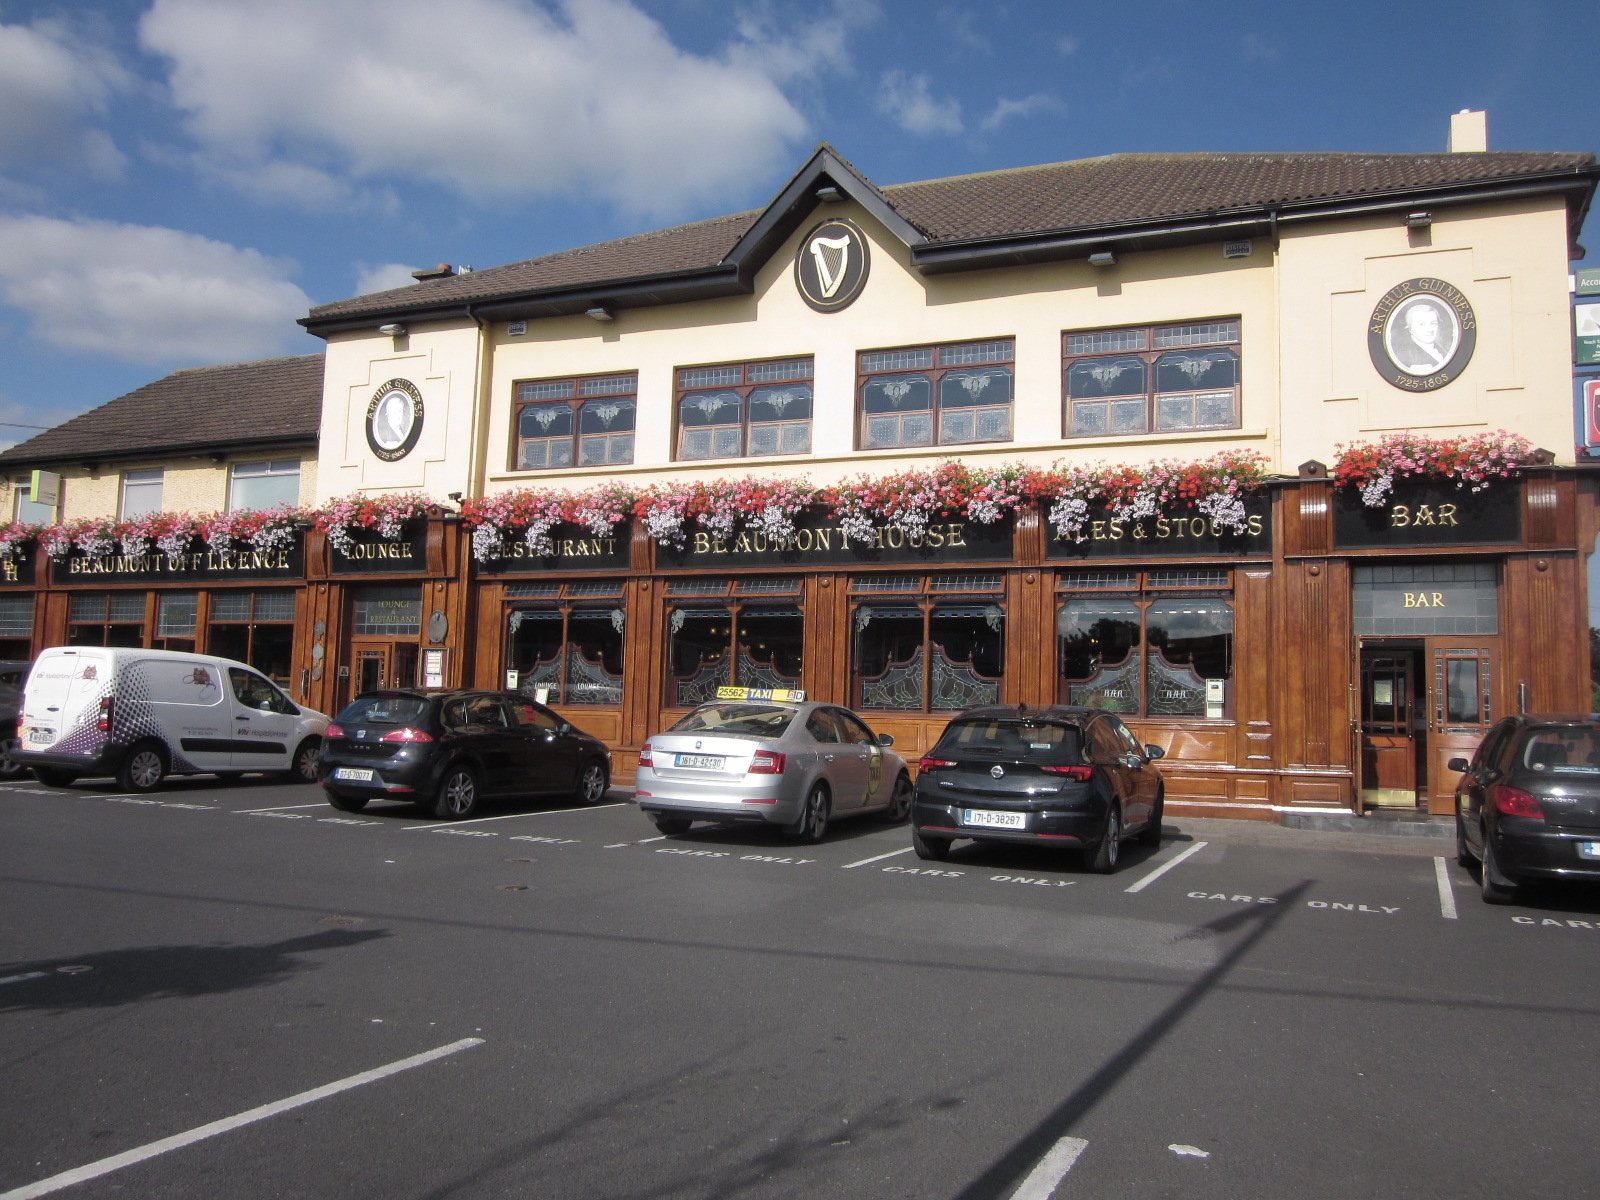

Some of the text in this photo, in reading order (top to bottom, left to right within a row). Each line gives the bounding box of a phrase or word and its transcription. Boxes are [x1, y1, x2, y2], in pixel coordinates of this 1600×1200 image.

[1581, 279, 1600, 288] Acco
[1371, 278, 1476, 334] ARTHUR GUINNESS
[1391, 503, 1458, 527] BAR
[1132, 523, 1148, 539] &
[1156, 514, 1264, 538] STOUS
[693, 527, 850, 554] BEAUMONT
[69, 554, 164, 575] BEAUMONT
[378, 600, 411, 609] LOUNGE
[1403, 592, 1446, 608] BAR
[369, 615, 417, 624] RESTAURANT
[718, 687, 744, 697] 25562
[749, 688, 773, 699] TAXI
[1103, 689, 1124, 698] BAR
[973, 811, 1021, 825] 171-D-38287
[881, 866, 1077, 887] CARS ONLY
[1187, 891, 1401, 914] CARS ONLY
[1511, 916, 1600, 929] CAR
